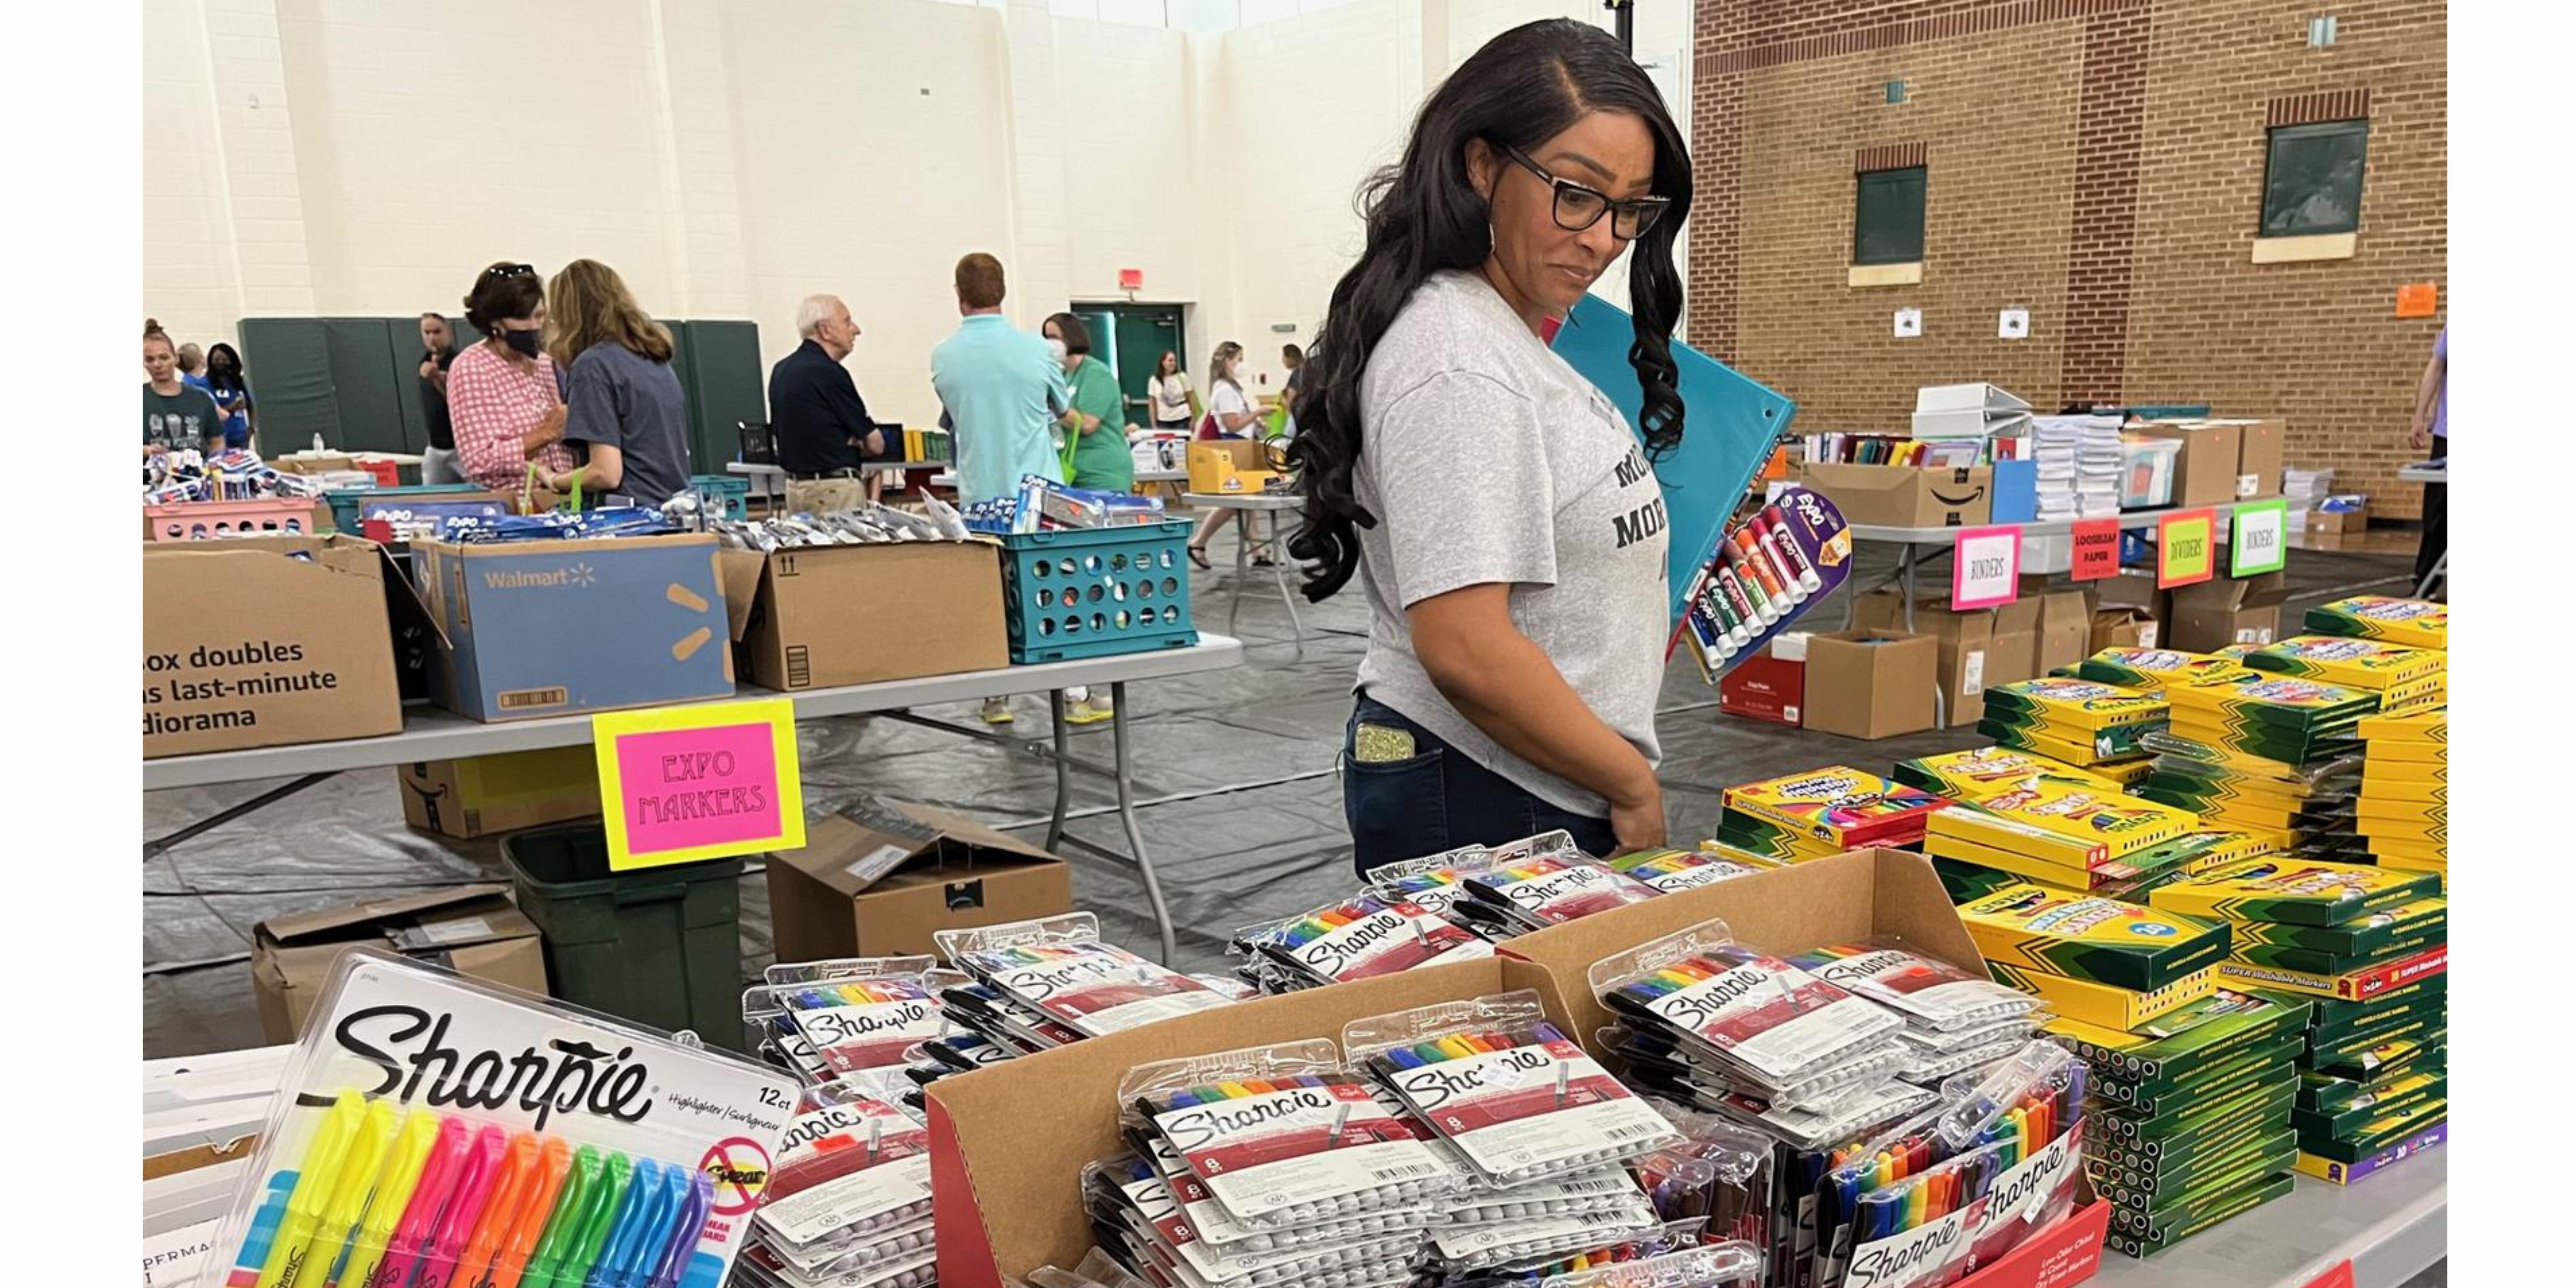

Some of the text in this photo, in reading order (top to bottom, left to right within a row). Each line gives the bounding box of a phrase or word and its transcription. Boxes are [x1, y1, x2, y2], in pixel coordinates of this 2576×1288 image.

[2170, 537, 2202, 561] DIVIDERS
[2247, 528, 2273, 550] BINDERS
[485, 568, 569, 588] Walmart
[1971, 557, 2005, 581] BINDERS
[189, 641, 303, 668] doubles
[171, 671, 337, 701] last-minute
[143, 709, 256, 735] diorama
[662, 751, 735, 783] EXPO
[638, 785, 766, 825] MARKERS
[1307, 913, 1405, 976] Sharpie
[1664, 968, 1768, 1030] Sharpie
[806, 1002, 924, 1046] Sharpie
[296, 1004, 653, 1132] Sharpie
[1405, 1050, 1550, 1111] Shaie
[1167, 1089, 1332, 1152] Sharpie
[143, 1243, 209, 1270] PERMA
[1851, 1218, 1958, 1288] Sharpie
